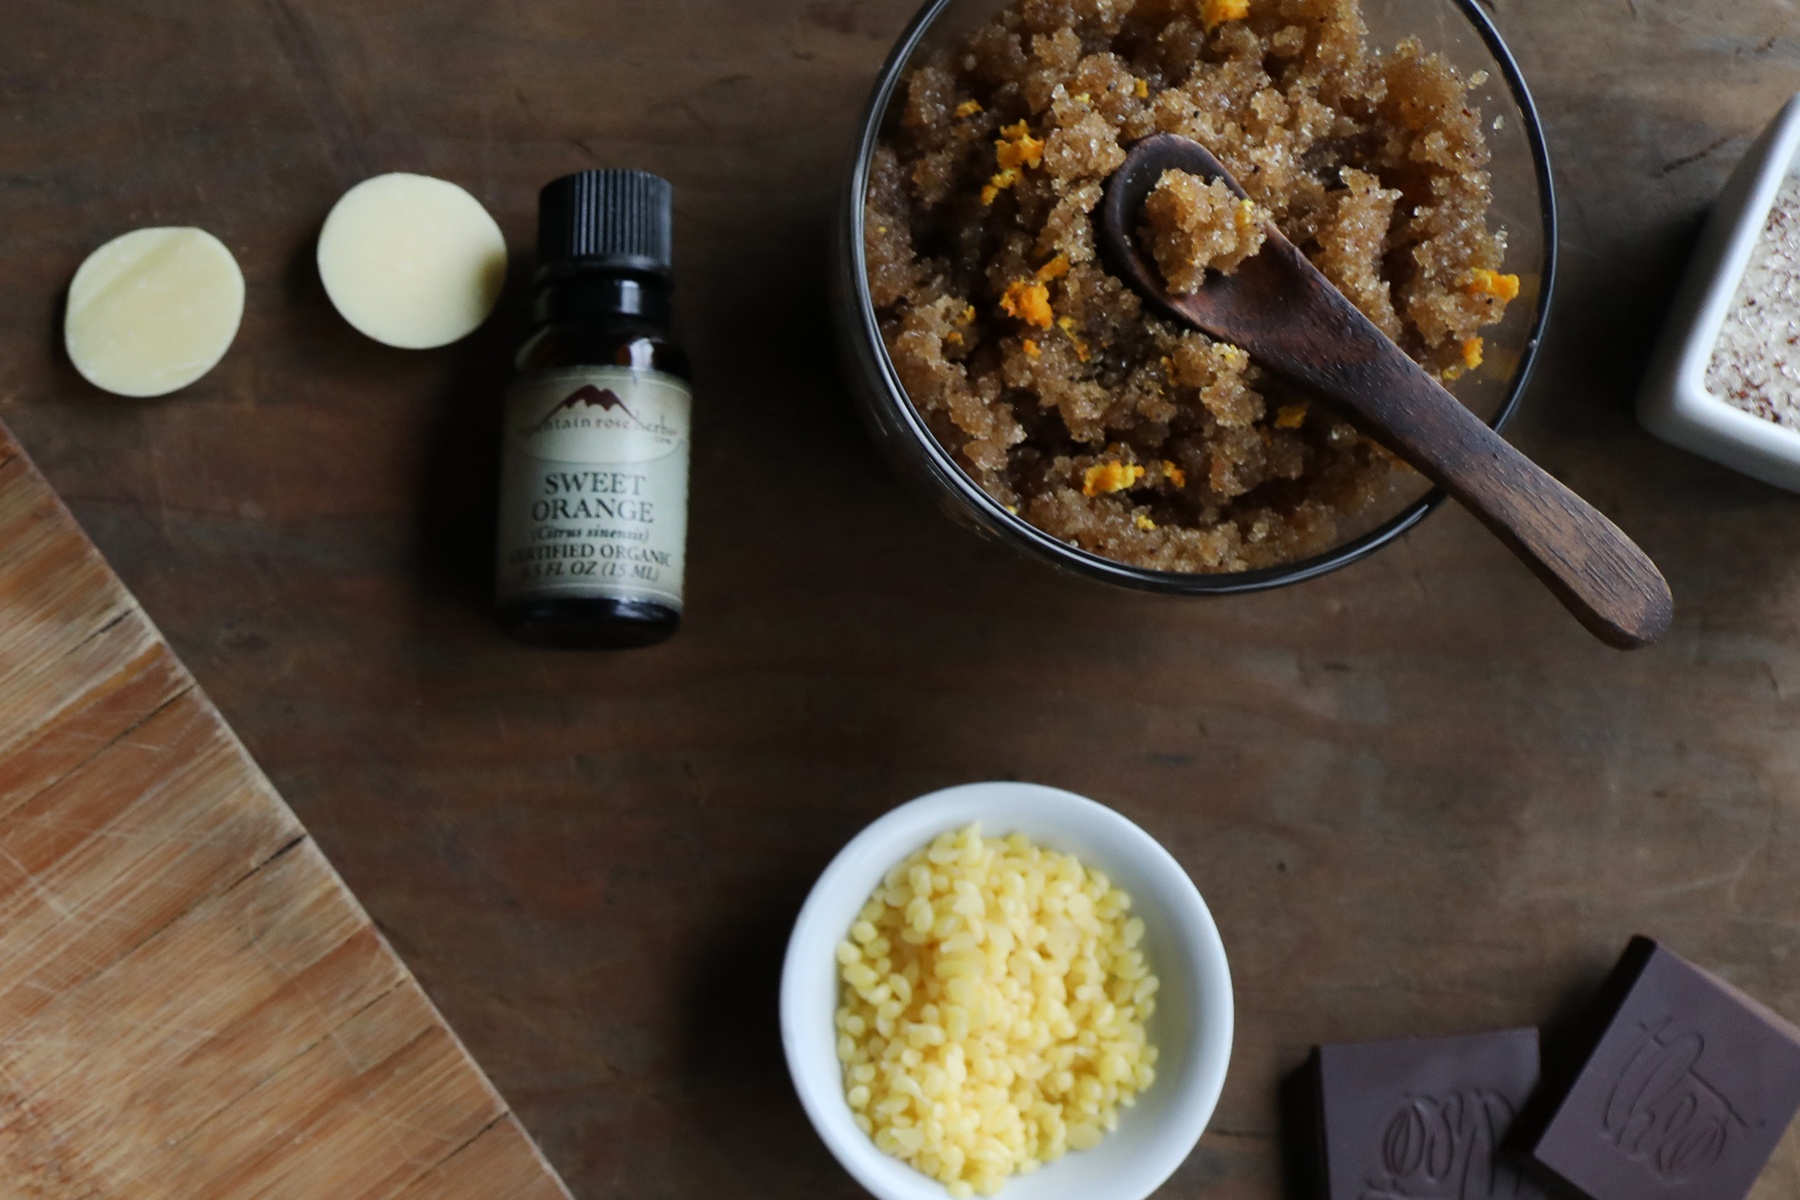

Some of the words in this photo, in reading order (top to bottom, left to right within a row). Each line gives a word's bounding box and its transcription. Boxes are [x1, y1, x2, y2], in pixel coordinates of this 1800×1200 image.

[544, 471, 647, 496] SWEET
[532, 497, 655, 525] ORANGE
[600, 543, 672, 568] ORGANIC
[570, 560, 598, 576] OZ
[601, 560, 627, 579] (15
[630, 564, 661, 583] ML)
